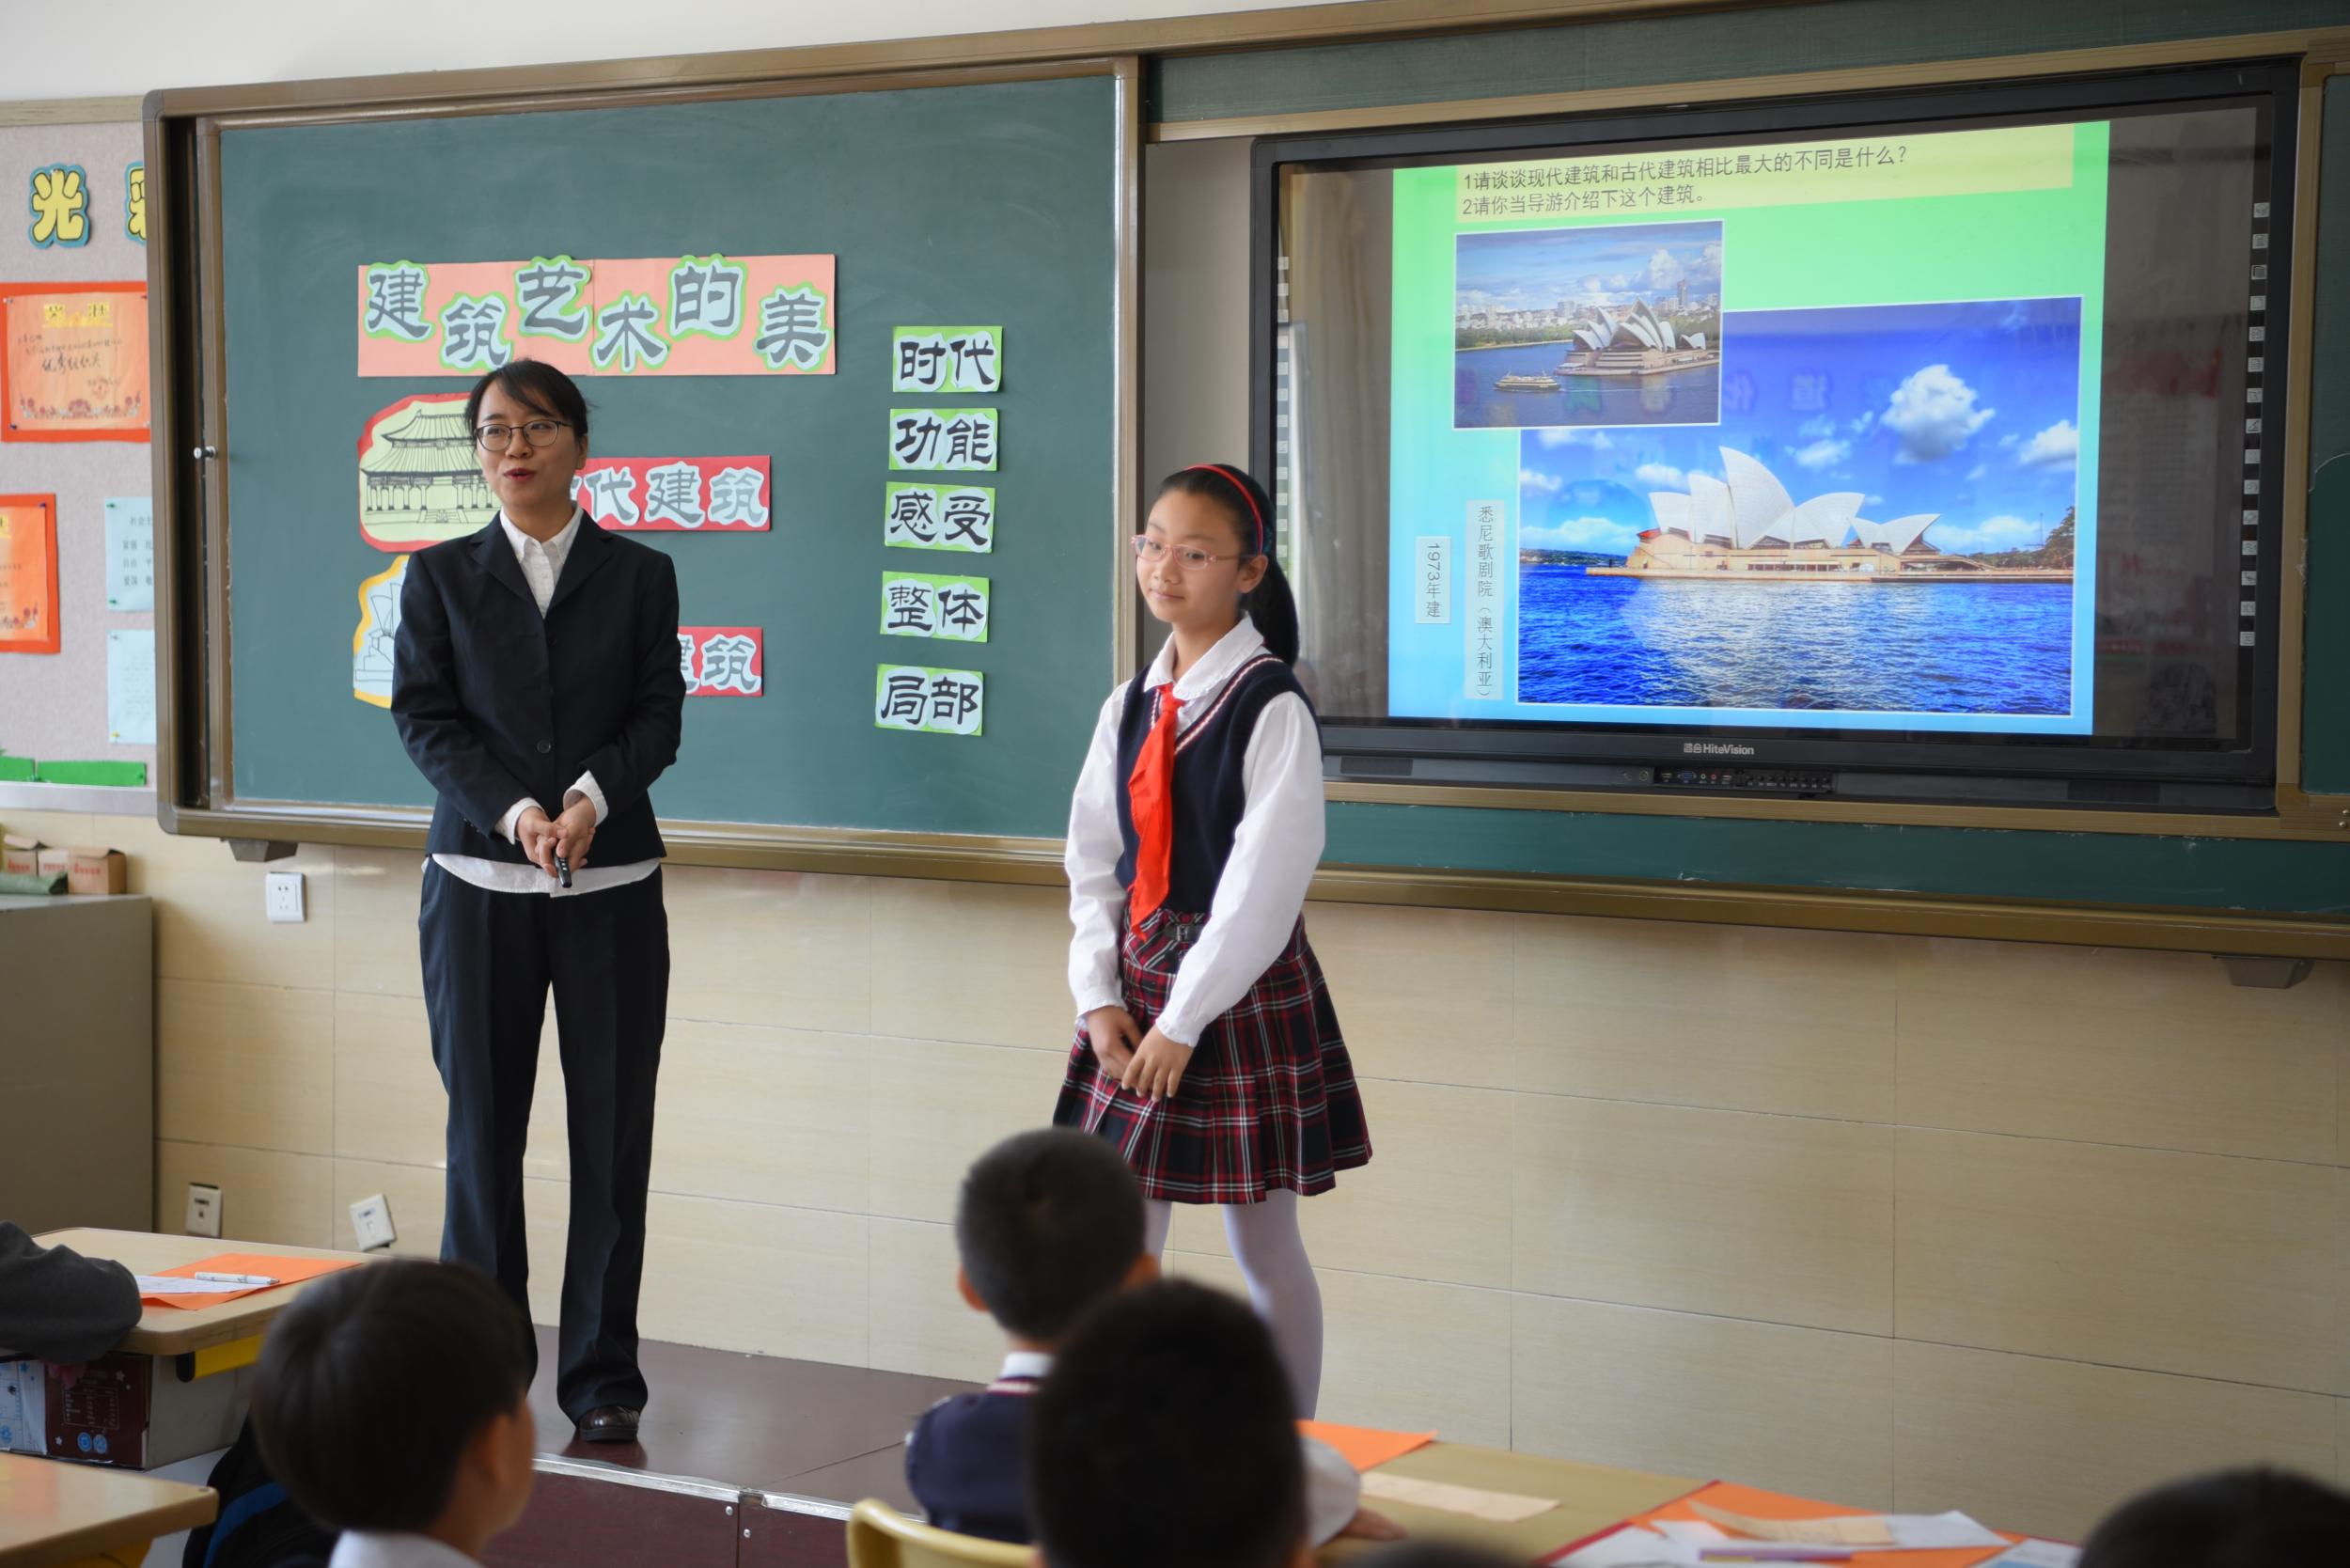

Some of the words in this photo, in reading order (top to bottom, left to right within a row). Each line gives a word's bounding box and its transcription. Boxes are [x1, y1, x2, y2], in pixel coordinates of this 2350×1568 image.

[367, 259, 829, 369] 建筑艺术的美
[899, 334, 997, 388] 时代
[893, 416, 996, 467] 功能
[570, 468, 766, 525] 代建筑
[890, 490, 993, 549] 感受
[1425, 542, 1442, 619] 1973年建
[886, 586, 986, 636] 整体
[881, 675, 979, 728] 局部
[1703, 744, 1754, 755] HiteVision
